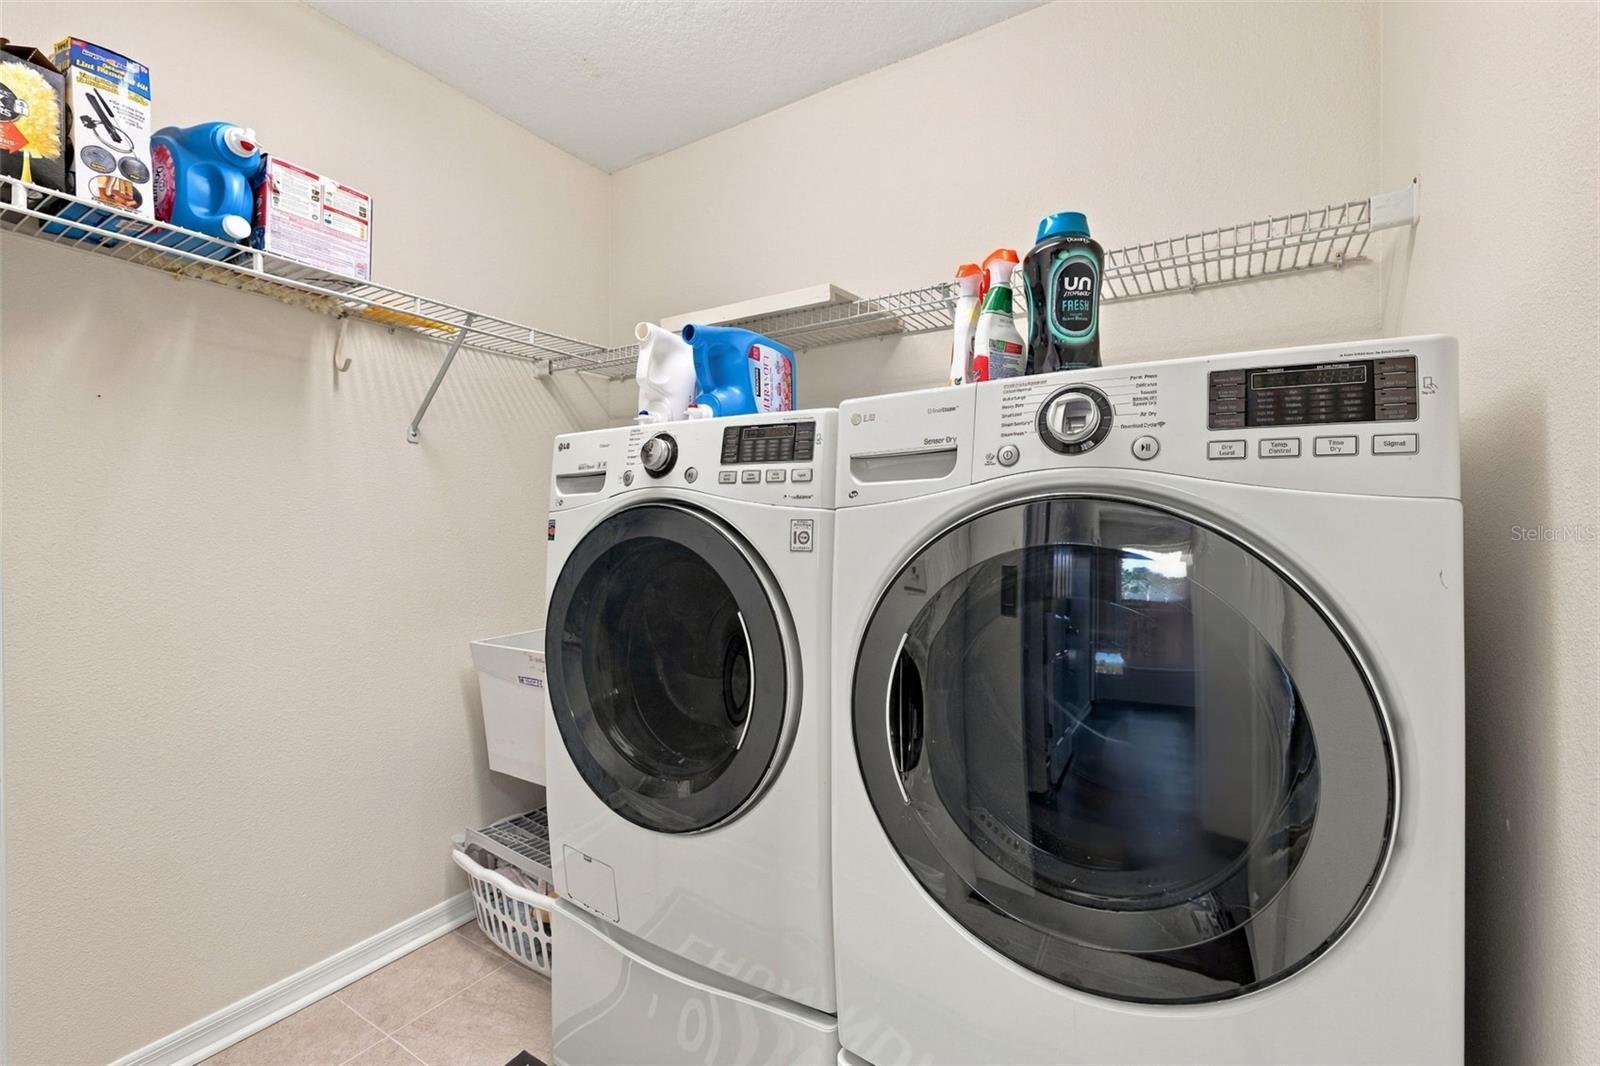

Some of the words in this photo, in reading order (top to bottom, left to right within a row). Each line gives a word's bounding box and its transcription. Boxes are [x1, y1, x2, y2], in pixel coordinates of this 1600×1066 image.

[1062, 299, 1089, 312] FRESH
[923, 438, 945, 446] Sensor
[945, 436, 957, 446] Dry
